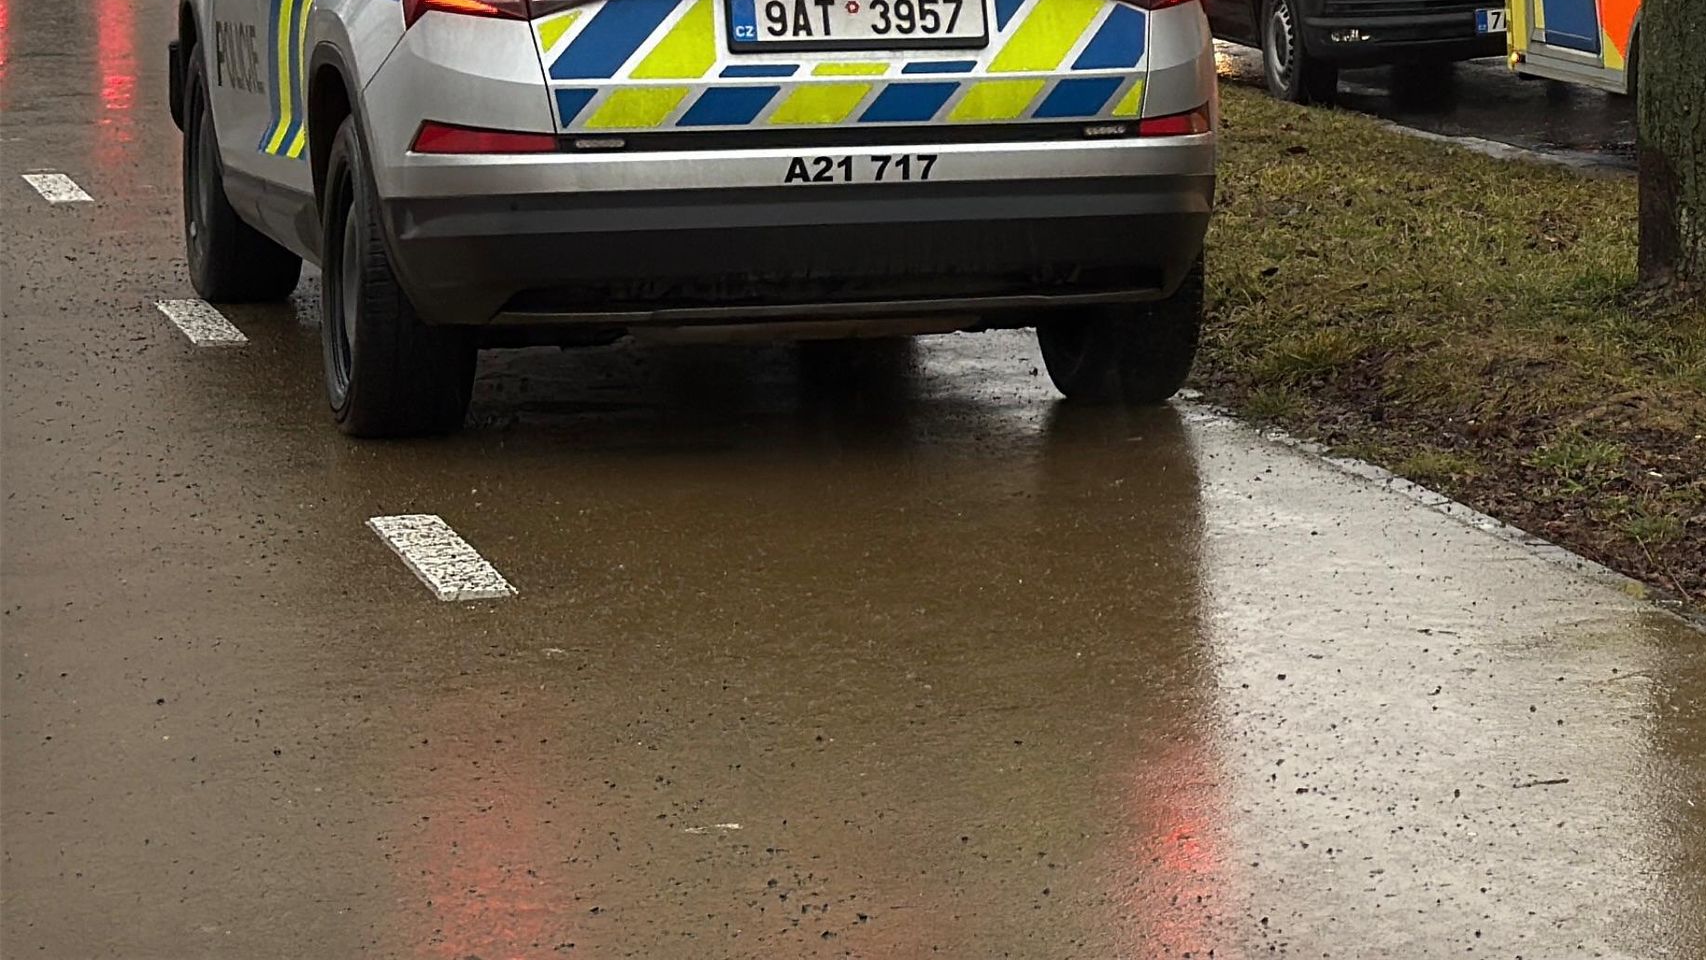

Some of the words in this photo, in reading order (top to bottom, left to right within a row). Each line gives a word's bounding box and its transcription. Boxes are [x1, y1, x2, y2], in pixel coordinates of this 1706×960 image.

[735, 25, 755, 38] CZ
[765, 0, 835, 38] 9AT
[1491, 11, 1506, 30] 7
[784, 155, 853, 184] A21
[870, 153, 938, 181] 717
